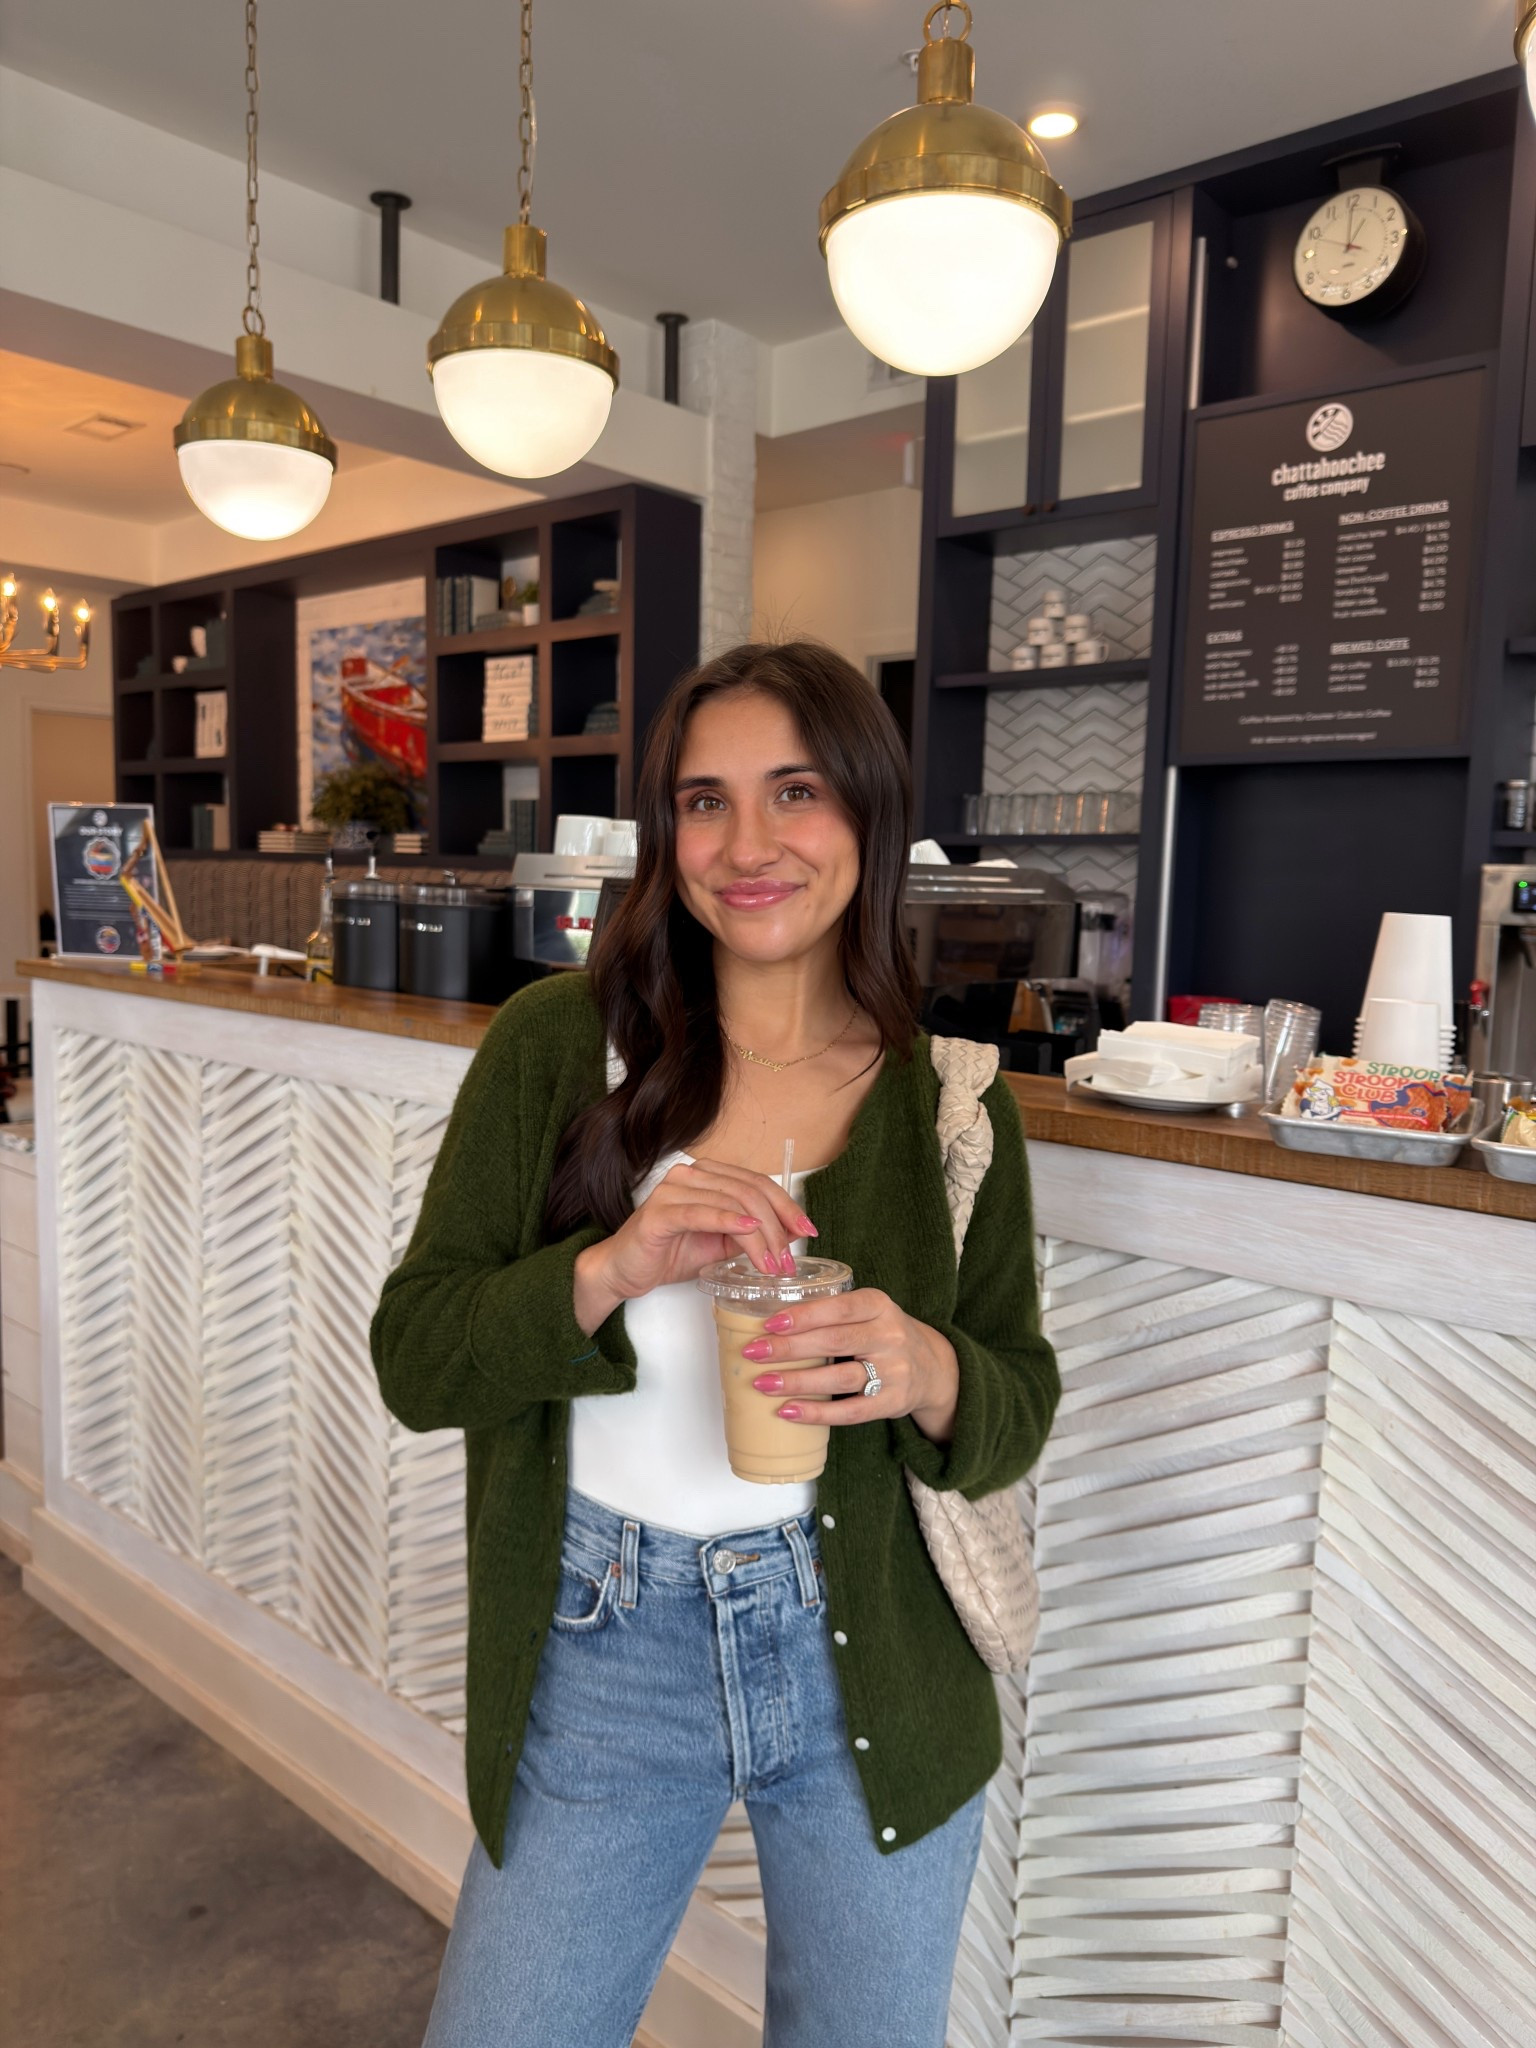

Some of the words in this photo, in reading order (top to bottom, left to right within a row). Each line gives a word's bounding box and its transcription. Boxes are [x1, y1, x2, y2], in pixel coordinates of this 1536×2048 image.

[1346, 194, 1360, 210] 12
[1326, 206, 1337, 221] 11
[1386, 207, 1396, 222] 2
[1308, 226, 1321, 240] 10
[1391, 230, 1400, 244] 3
[1306, 271, 1315, 285] 8
[1342, 287, 1352, 300] 6
[1271, 450, 1386, 486] chattahoochee
[1283, 483, 1319, 502] coffee
[1320, 476, 1371, 496] company
[1408, 500, 1450, 516] DRINKS
[1260, 520, 1295, 537] DRINKS
[1206, 630, 1243, 645] EXTRAS
[1330, 640, 1374, 656] BREWED
[1366, 1061, 1441, 1082] STROOP
[1333, 1071, 1410, 1090] STROOP
[1341, 1083, 1398, 1103] CLUB
